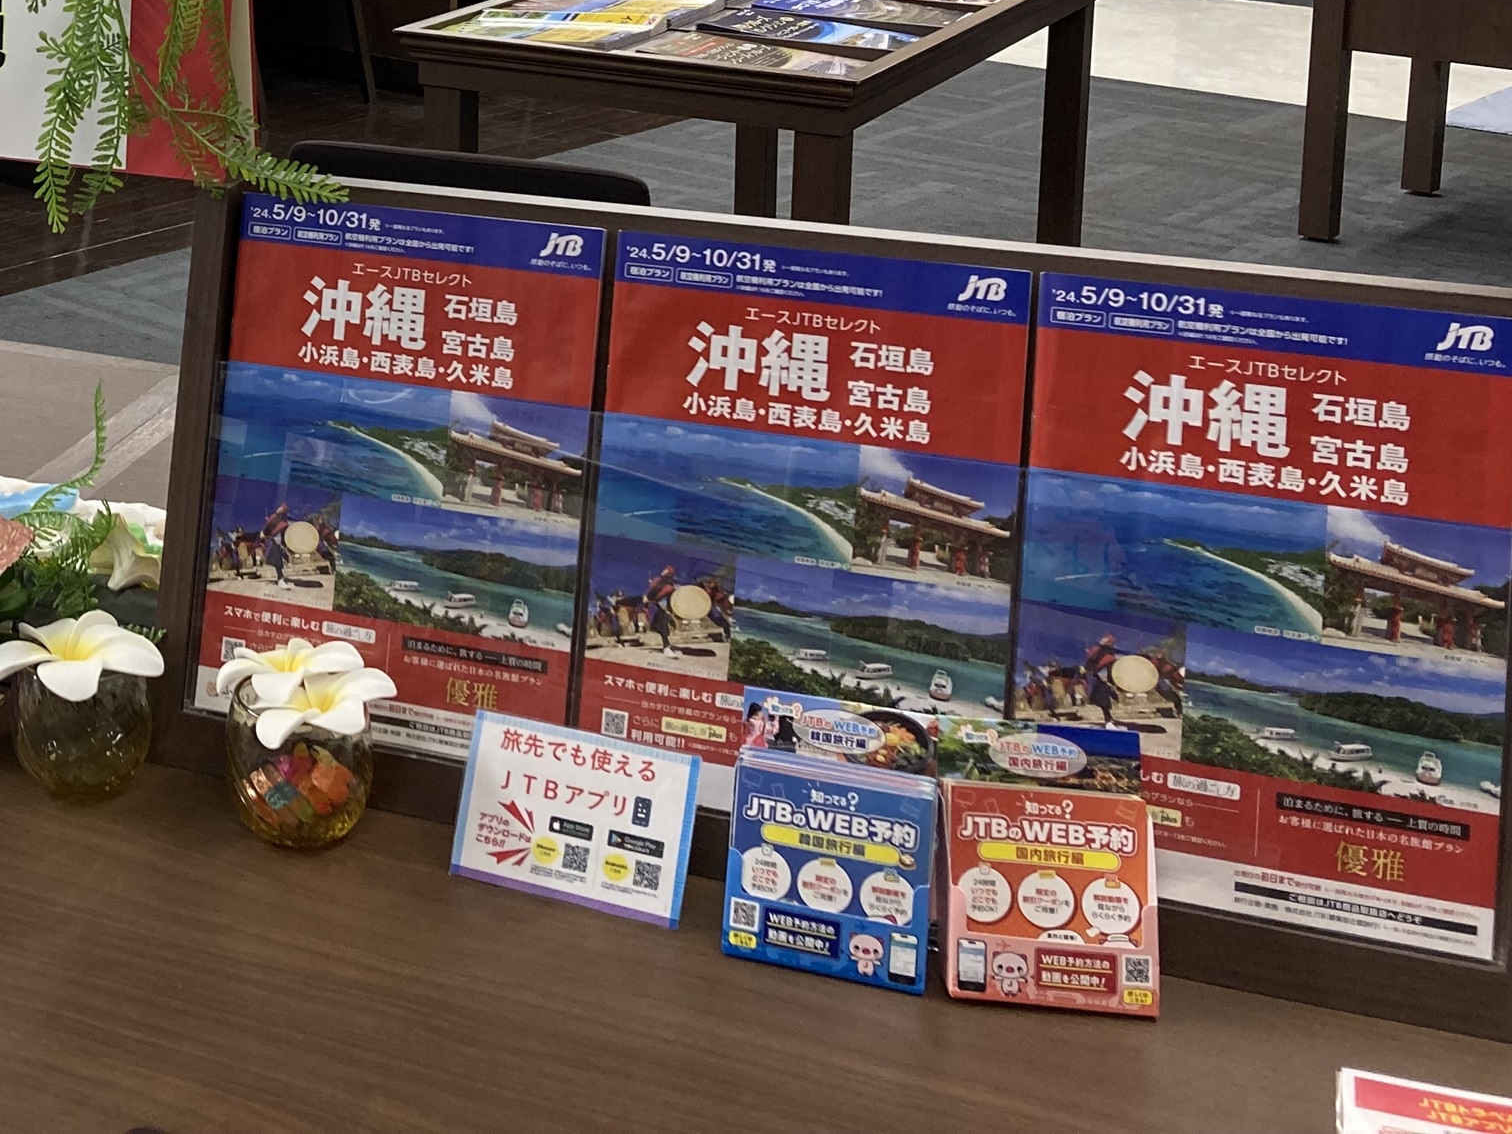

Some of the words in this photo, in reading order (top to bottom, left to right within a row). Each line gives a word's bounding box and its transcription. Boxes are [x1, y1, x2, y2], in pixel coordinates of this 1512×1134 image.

[539, 232, 585, 257] JTB
[353, 263, 472, 287] エースJTBセレクト
[957, 275, 1008, 302] JTB
[301, 276, 426, 350] 沖縄
[443, 294, 518, 326] 石垣島
[745, 308, 881, 334] エースJTBセレクト
[441, 330, 515, 362] 宮古島
[1437, 322, 1493, 353] JTB
[686, 321, 830, 402] 沖縄
[849, 341, 934, 376] 石垣島
[1188, 355, 1348, 386] エースJTBセレクト
[847, 380, 932, 415] 宮古島
[1122, 370, 1290, 459] 沖縄
[1311, 393, 1411, 432] 石垣島
[1310, 436, 1409, 473] 宮古島
[224, 605, 320, 630] スマホで便利に楽しむ
[446, 677, 498, 710] 優雅
[604, 674, 712, 703] スマホで便利に楽しむ
[810, 731, 866, 749] 韓国旅行編
[999, 743, 1079, 760] JTBのWEB予約
[500, 728, 656, 782] 旅先でも使える
[1008, 756, 1067, 772] 国内旅行編
[478, 823, 532, 843] ダウンロードは
[480, 812, 509, 826] アプリの
[744, 794, 920, 851] JTBのWEB予約
[799, 833, 866, 857] 韓国旅行編
[959, 815, 1136, 855] JTBのWEB予約
[1016, 846, 1085, 866] 国内旅行編
[1335, 840, 1405, 883] 優雅
[971, 888, 998, 896] いつでも
[972, 896, 998, 905] どこでも
[1091, 912, 1131, 923] らくらく予約
[1097, 903, 1125, 913] 見ながら
[1041, 954, 1110, 970] WEB予約方法の
